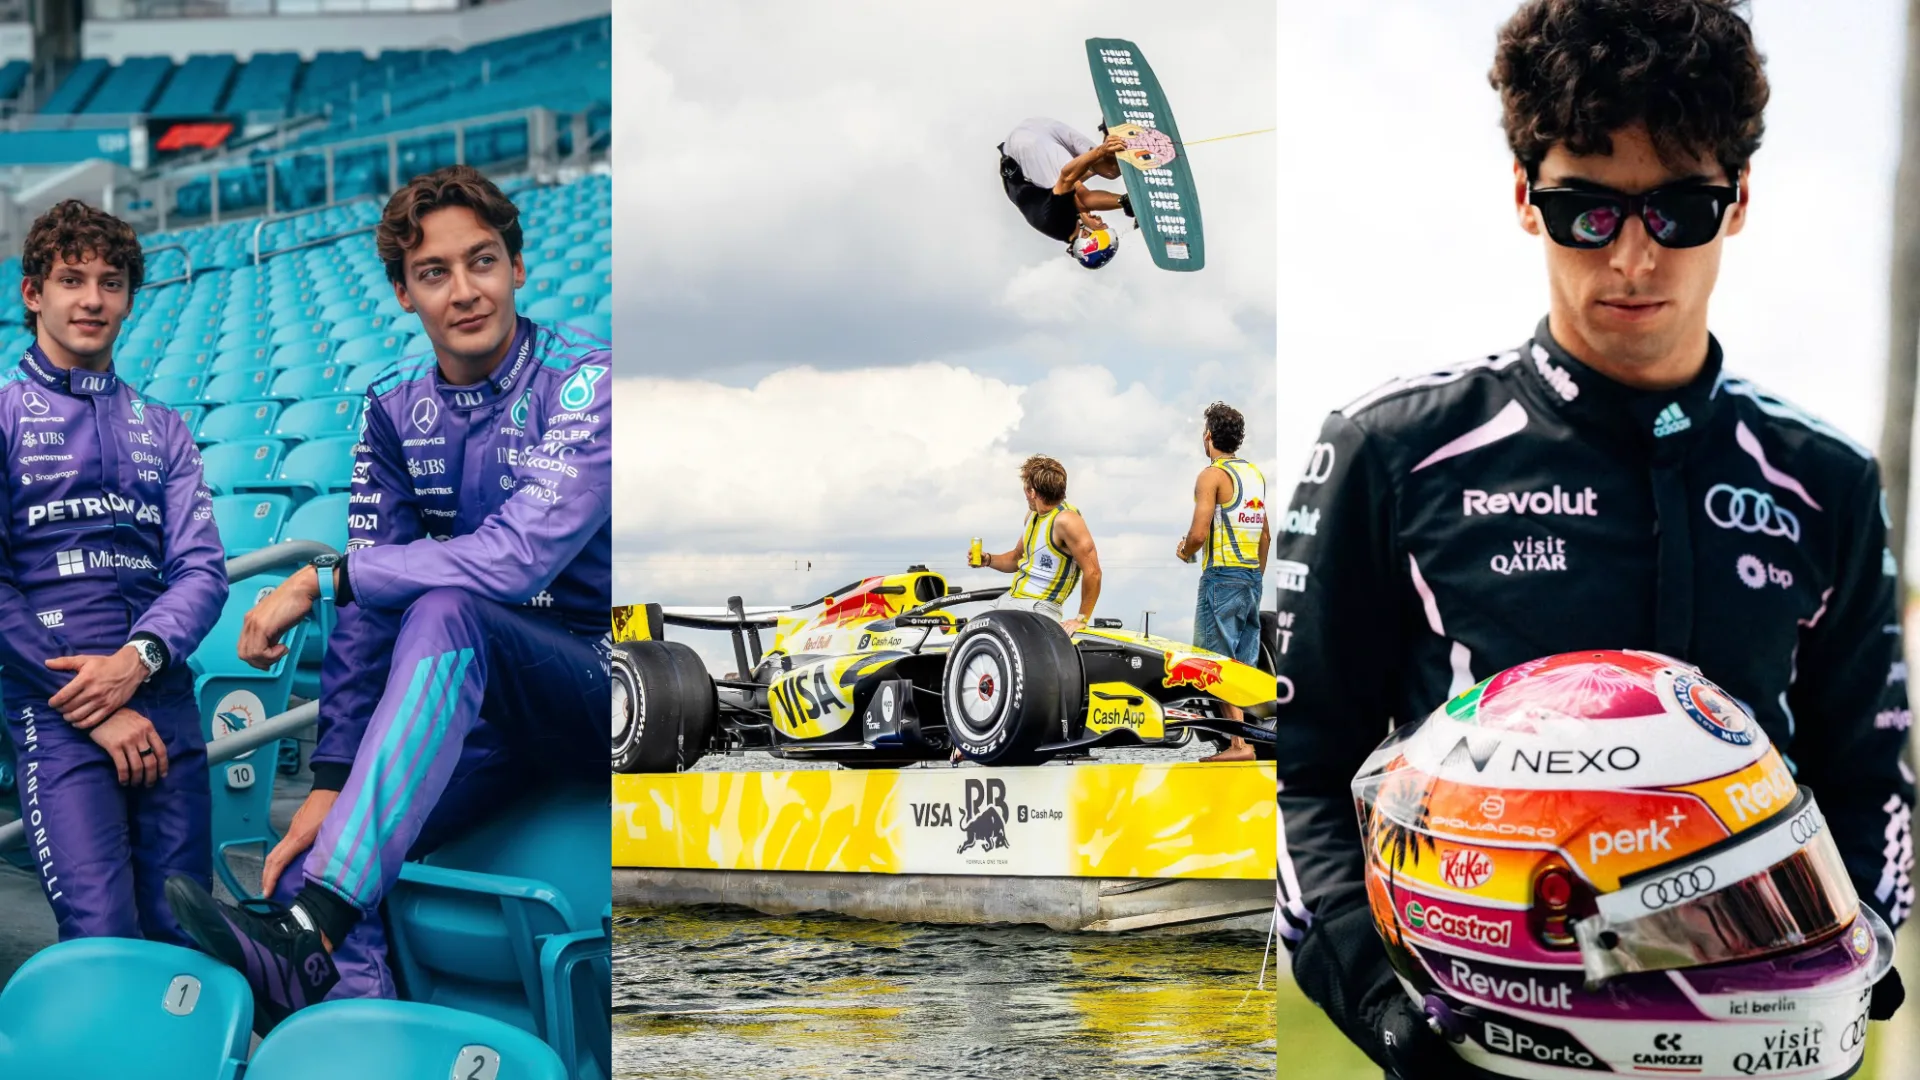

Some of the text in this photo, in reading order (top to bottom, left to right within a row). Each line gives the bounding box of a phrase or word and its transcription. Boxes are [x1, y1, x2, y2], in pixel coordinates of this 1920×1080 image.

[1102, 57, 1133, 67] FORCE
[1110, 77, 1141, 86] FORCE
[1118, 98, 1149, 107] FORCE
[1144, 177, 1174, 187] FORCE
[1150, 200, 1181, 210] FORCE
[1157, 224, 1187, 235] FORCE
[40, 432, 65, 446] UBS
[35, 468, 79, 481] Snapdragon
[28, 492, 162, 527] PETRONAS
[1463, 485, 1598, 517] Revolut
[1238, 512, 1256, 523] Red
[1511, 536, 1567, 555] visit
[88, 551, 159, 571] Microsoft
[1490, 555, 1568, 576] QATAR
[1767, 562, 1793, 590] bp
[871, 637, 888, 647] Cash
[771, 663, 847, 729] VISA
[1093, 707, 1146, 729] Cash App
[961, 741, 998, 755] ZERO
[1510, 746, 1641, 774] NEXO
[233, 767, 250, 783] 10
[909, 803, 954, 827] VISA
[1031, 808, 1064, 822] Cash App
[27, 761, 63, 900] ANTONELLI
[1431, 816, 1557, 838] PIQUADRO
[1444, 850, 1492, 888] KitKat
[1424, 905, 1513, 948] Castrol
[179, 983, 189, 1008] 1
[1450, 960, 1573, 1010] Revolut
[1729, 999, 1797, 1015] ic! berlin
[1764, 1026, 1823, 1051] visit
[1515, 1032, 1595, 1067] Porto
[1632, 1053, 1704, 1066] CAMOZZI
[467, 1055, 485, 1080] 2
[1732, 1046, 1821, 1075] QATAR
